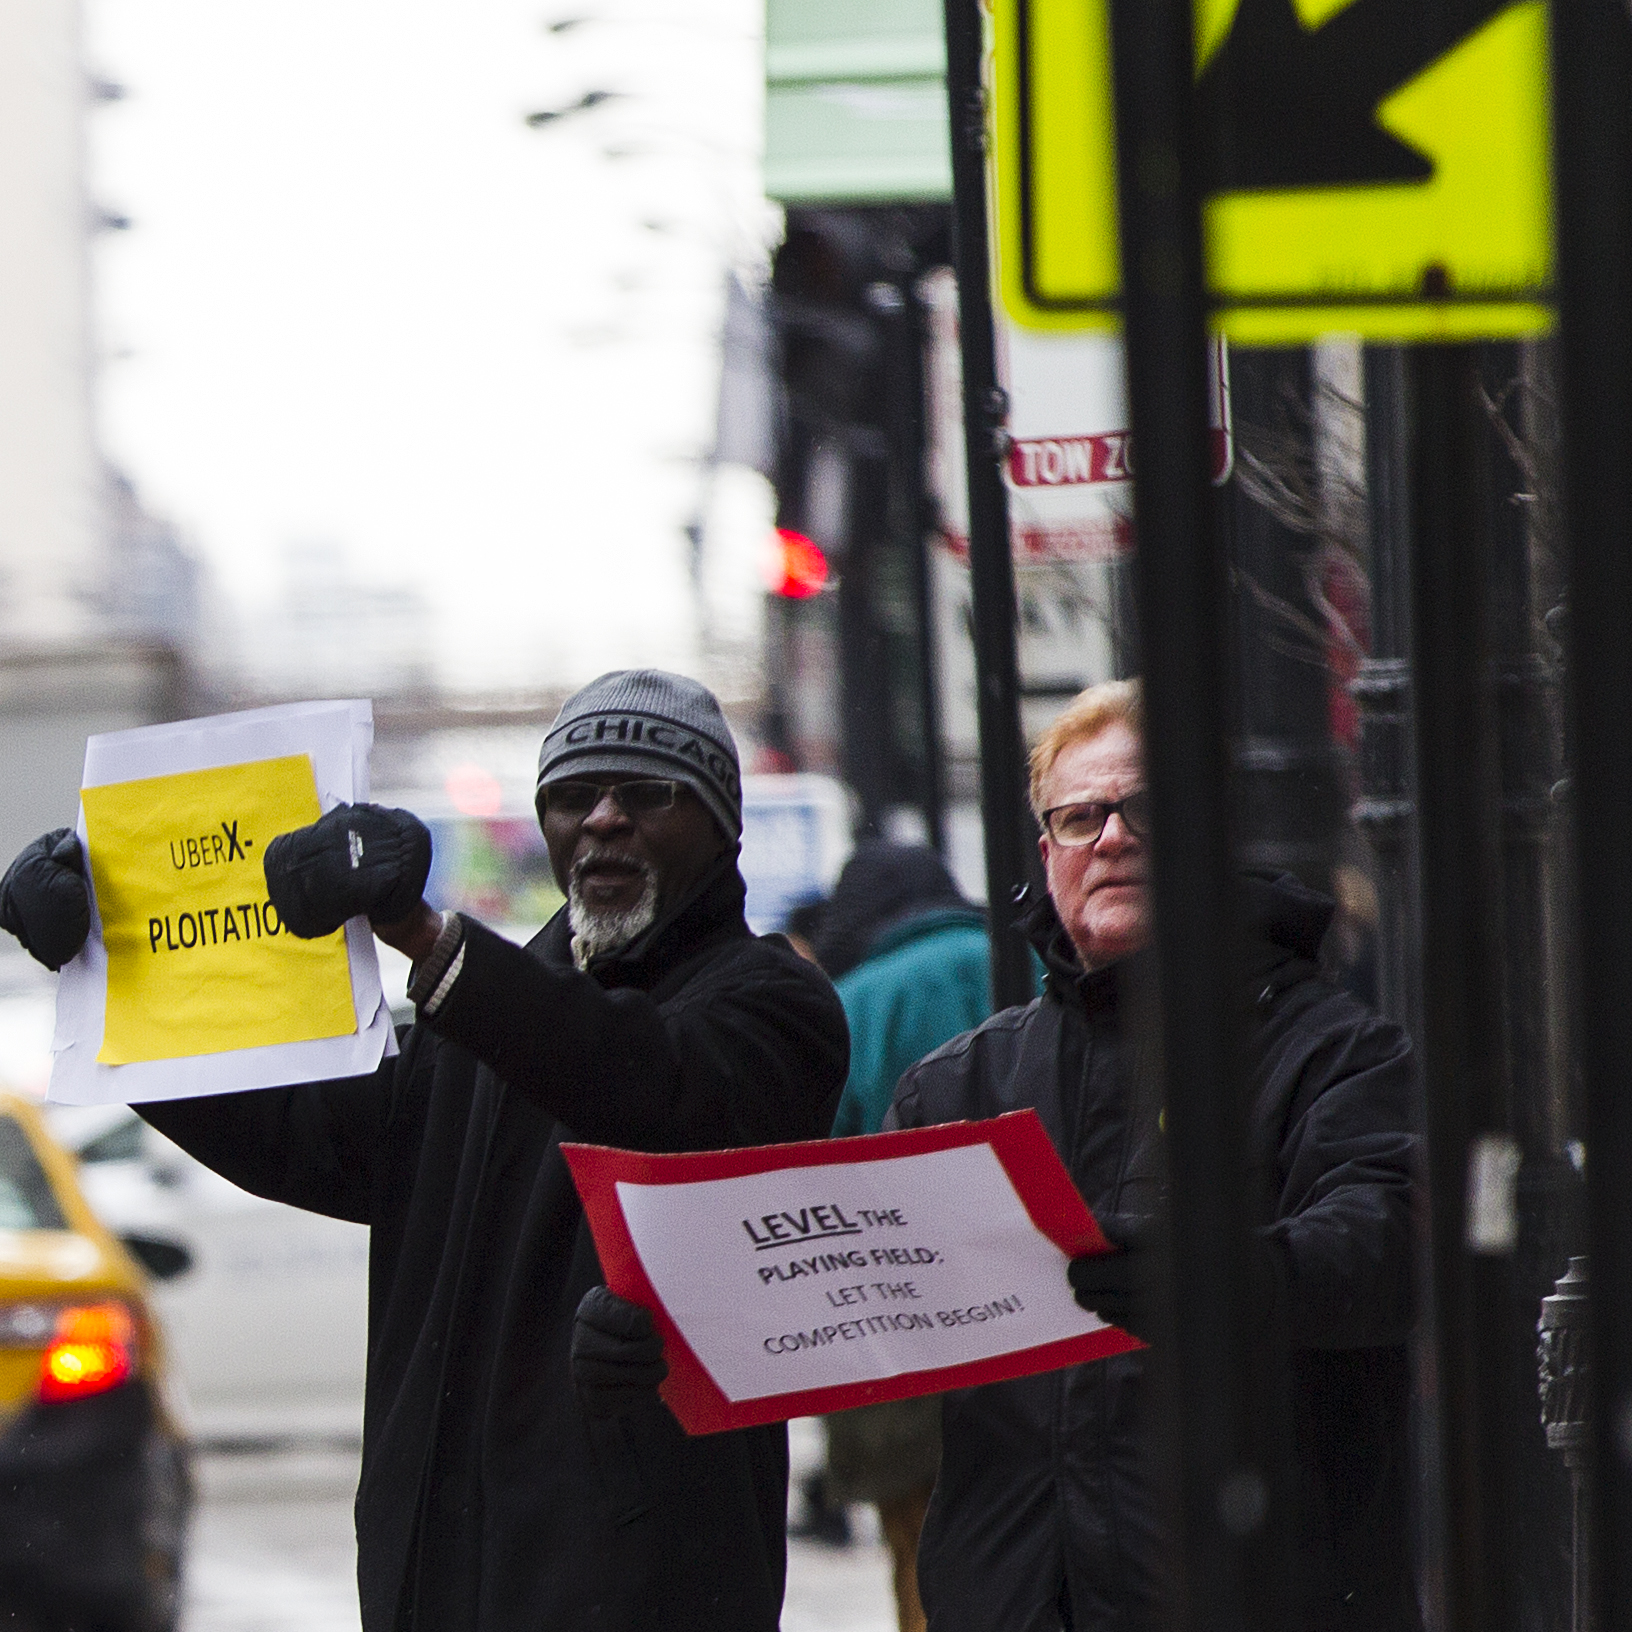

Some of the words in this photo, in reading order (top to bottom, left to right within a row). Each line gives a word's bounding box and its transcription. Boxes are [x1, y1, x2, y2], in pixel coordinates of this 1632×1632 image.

[1018, 440, 1093, 484] TOW
[169, 819, 254, 870] UBERX-
[148, 899, 292, 954] PLOITATIO
[742, 1204, 859, 1246] LEVEL
[857, 1208, 908, 1228] THE
[757, 1250, 867, 1286] PLAYING
[825, 1284, 868, 1308] LET
[870, 1281, 923, 1300] THE
[763, 1312, 935, 1355] COMPETITION
[936, 1293, 1026, 1329] BEGIN!
